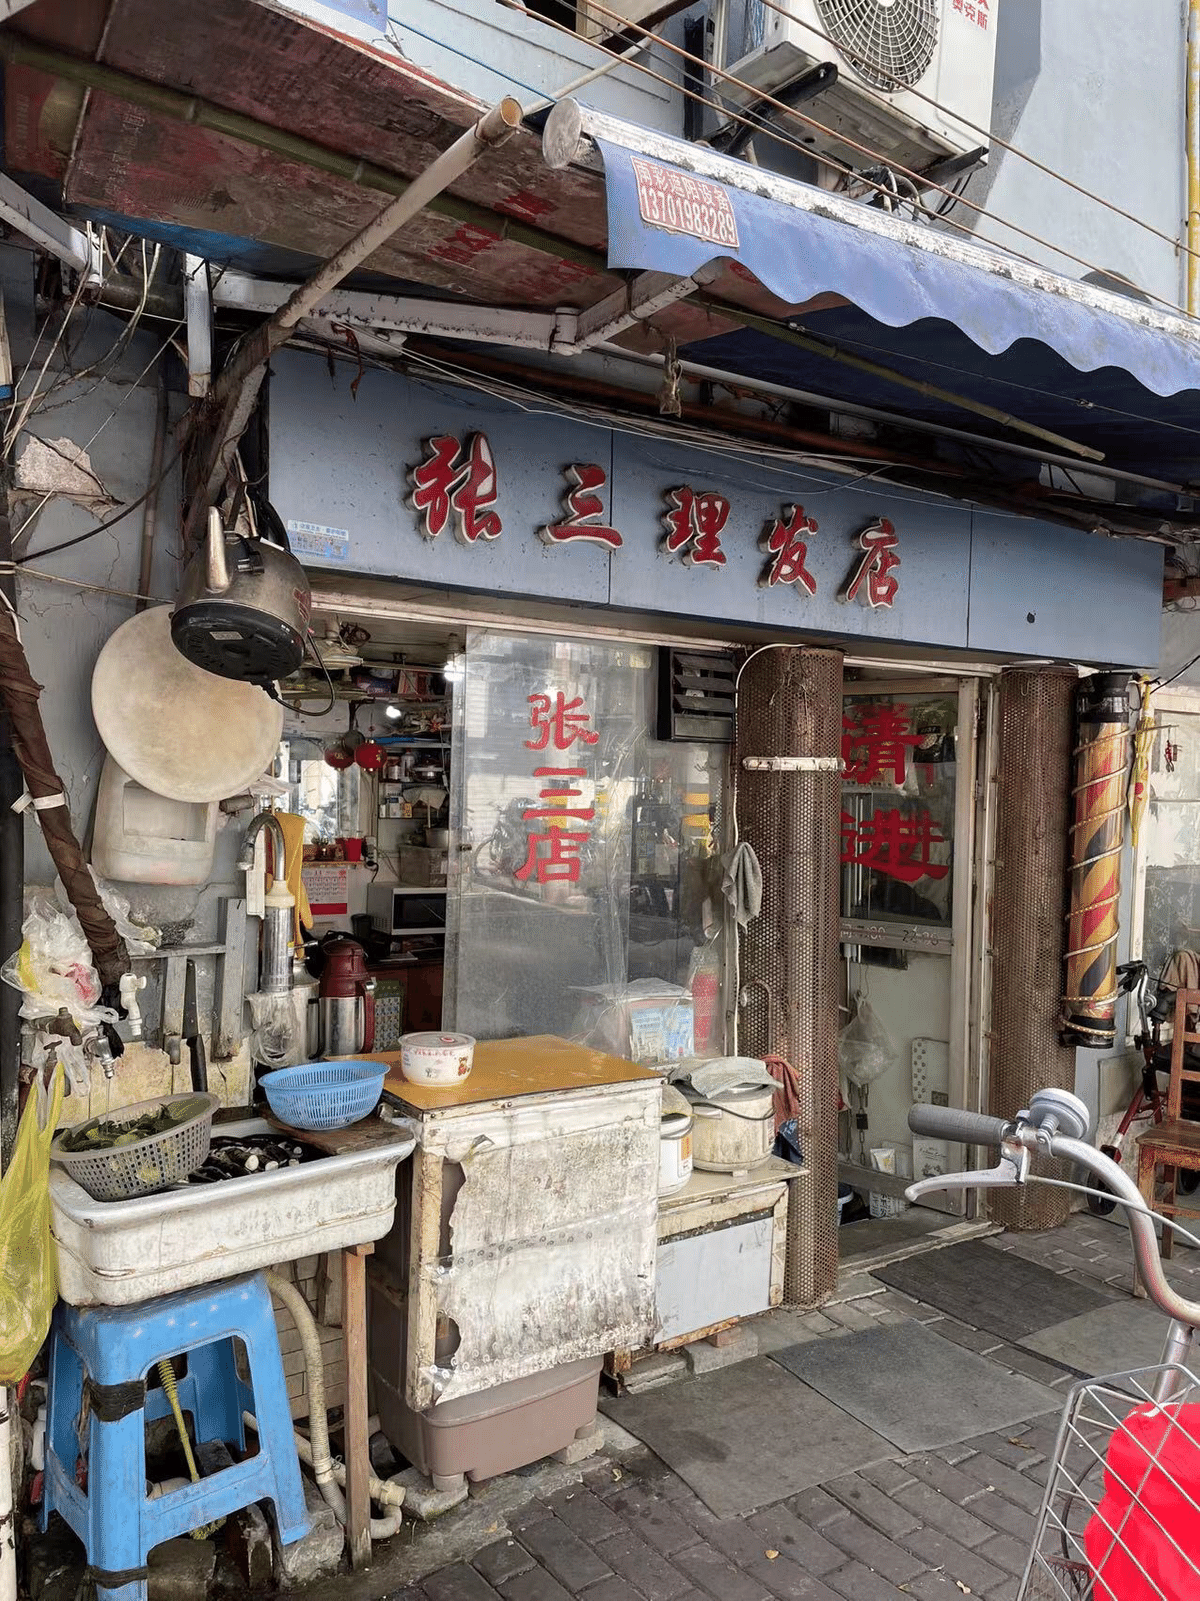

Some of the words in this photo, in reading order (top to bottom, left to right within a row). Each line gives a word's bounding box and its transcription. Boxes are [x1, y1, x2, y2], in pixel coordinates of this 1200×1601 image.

[641, 186, 735, 244] 13701983289
[405, 430, 901, 608] 张三理发店
[514, 691, 599, 885] 张三店
[841, 704, 940, 882] 请进
